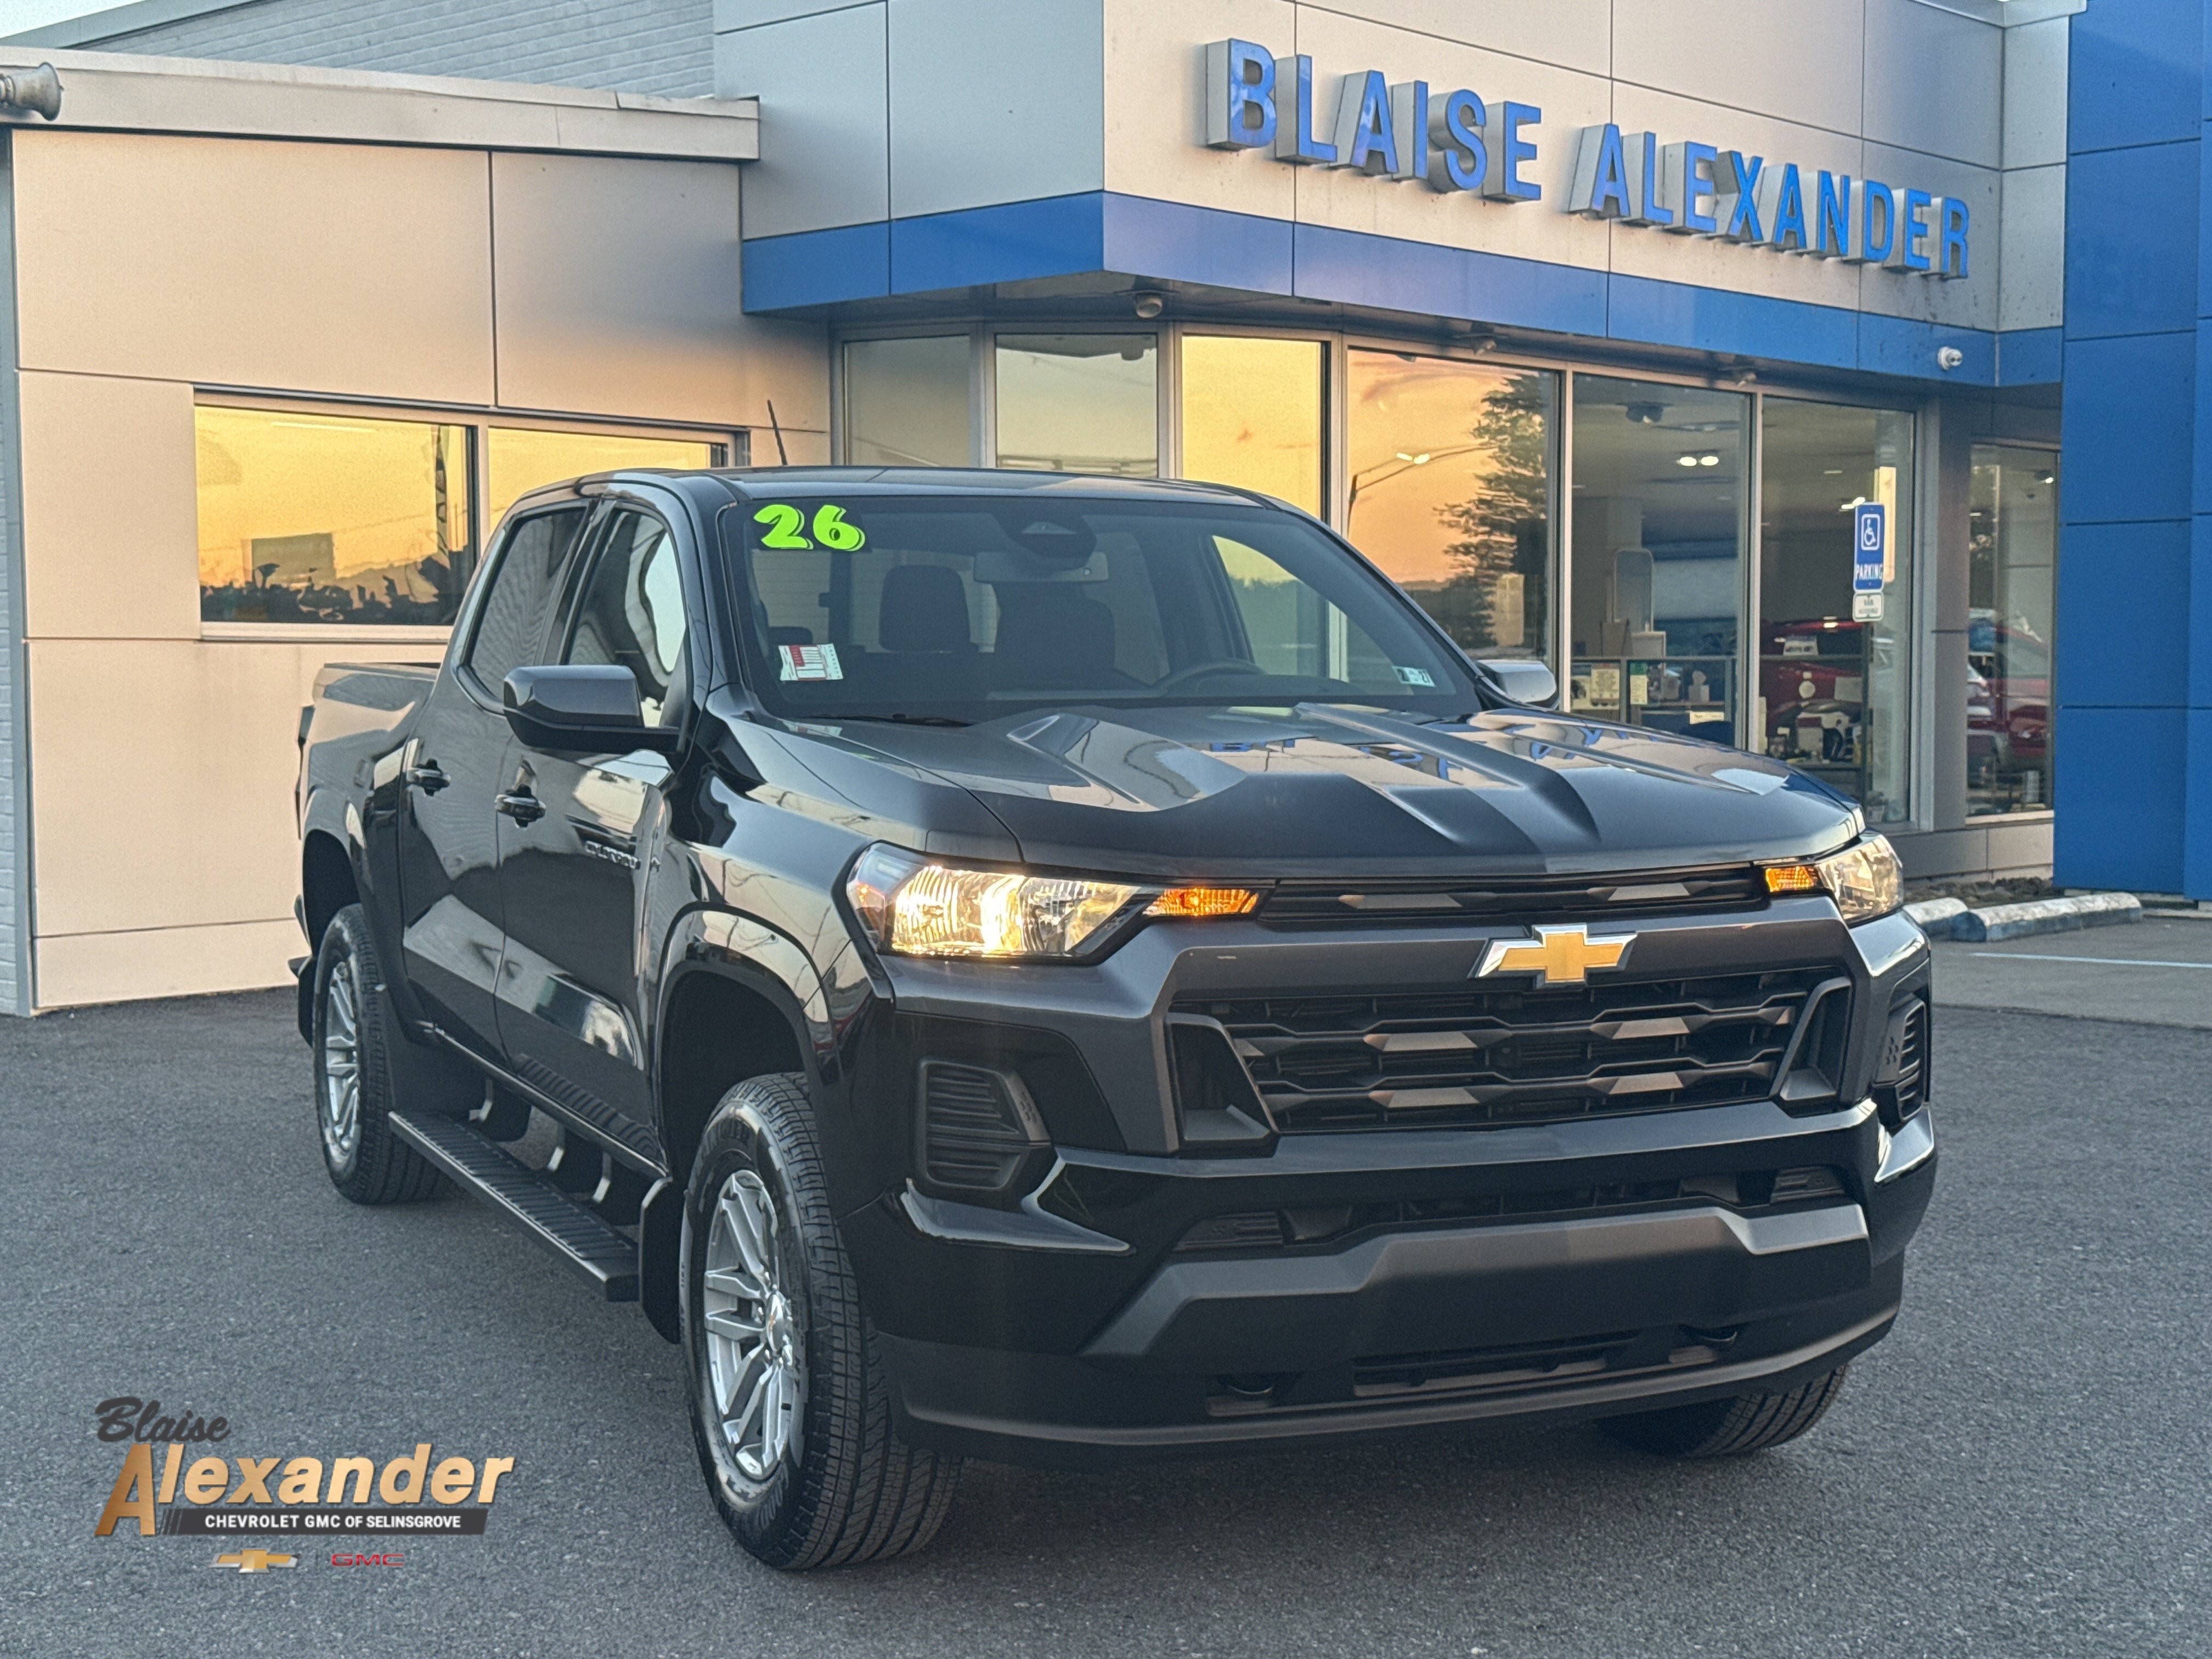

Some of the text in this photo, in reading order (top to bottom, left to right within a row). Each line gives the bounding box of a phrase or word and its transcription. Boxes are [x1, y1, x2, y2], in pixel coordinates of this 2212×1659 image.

[1228, 37, 1970, 278] BLAISE ALEXANDER
[753, 504, 866, 552] 26
[1855, 563, 1883, 580] PARKING
